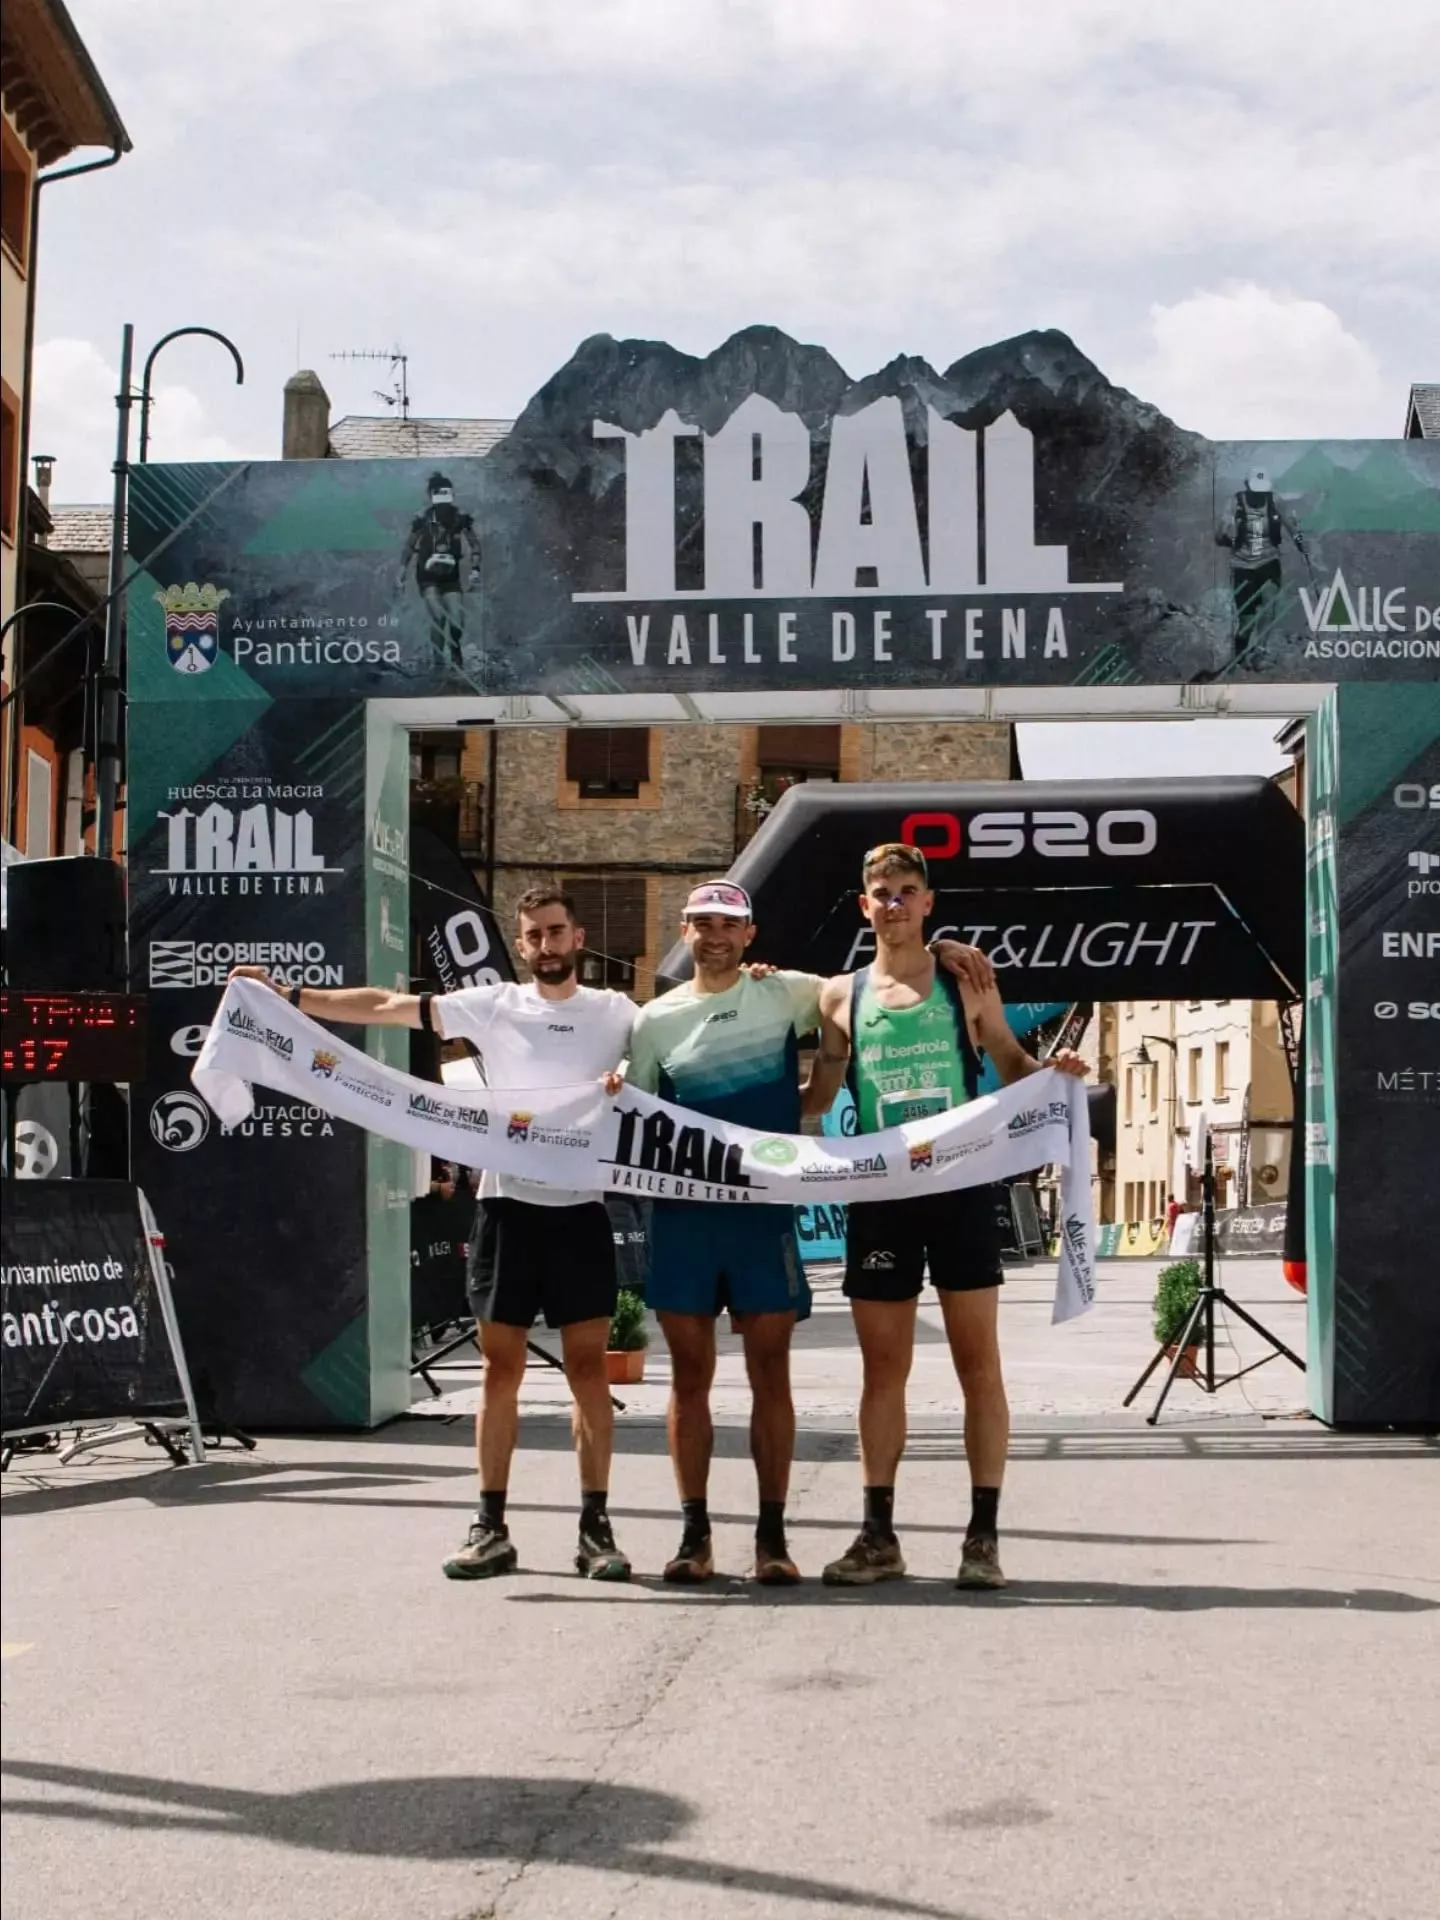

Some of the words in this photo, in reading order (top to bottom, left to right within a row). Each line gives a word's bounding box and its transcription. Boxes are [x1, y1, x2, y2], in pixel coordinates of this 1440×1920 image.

[593, 393, 1068, 595] TRAIL
[1298, 567, 1406, 632] VALLE
[232, 615, 368, 632] Ayuntamiento
[378, 614, 399, 627] de
[627, 612, 798, 666] VALLE
[832, 610, 892, 662] DE
[925, 607, 1069, 660] TENA
[233, 635, 401, 665] Panticosa
[1304, 640, 1440, 658] ASOCIACION
[157, 802, 325, 871] TRAIL
[168, 877, 229, 896] VALLE
[239, 877, 263, 894] DE
[273, 877, 325, 894] TENA
[196, 942, 325, 963] GOBIERNO
[842, 921, 1216, 971] FT&LIGHT
[196, 966, 229, 986] DE
[264, 965, 344, 986] AGON
[220, 1122, 334, 1136] HUESCA
[612, 1105, 751, 1186] TRAIL
[612, 1169, 666, 1194] VALLE
[675, 1181, 695, 1197] DE
[705, 1185, 750, 1201] TENA
[103, 1255, 124, 1280] de
